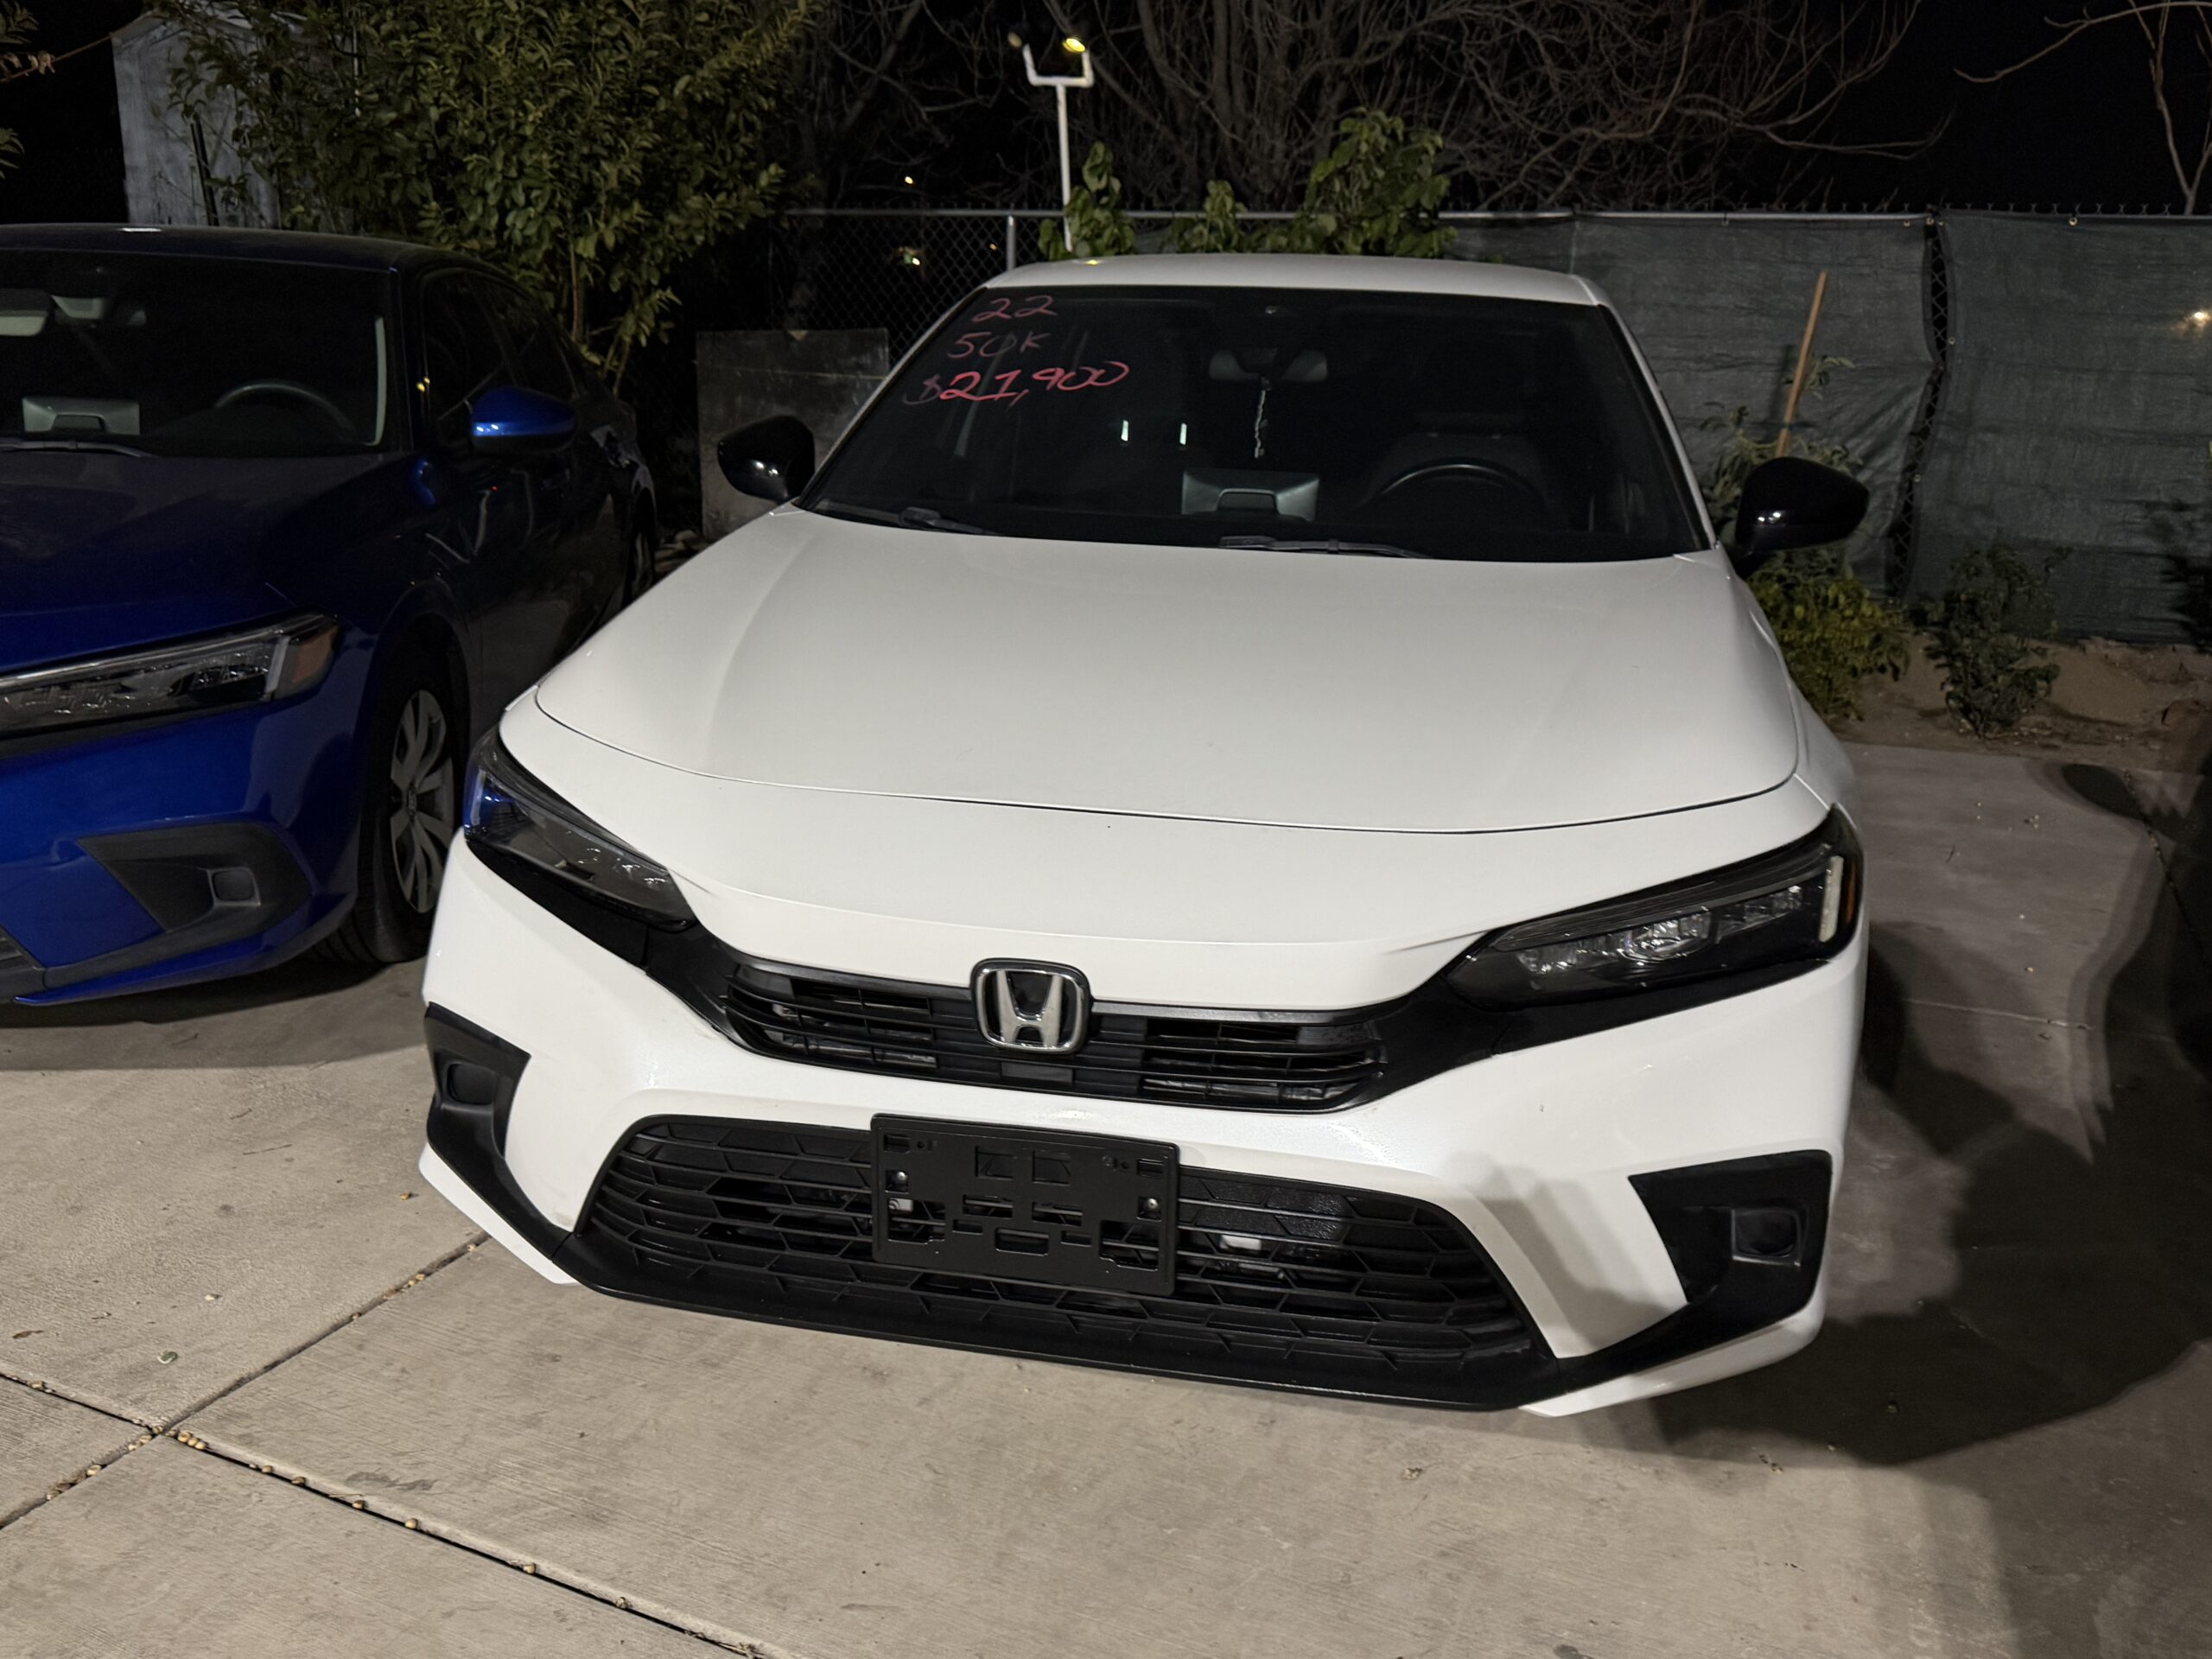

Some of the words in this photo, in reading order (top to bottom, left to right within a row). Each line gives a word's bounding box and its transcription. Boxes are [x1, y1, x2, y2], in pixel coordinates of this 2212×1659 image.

[971, 295, 1058, 322] 22
[946, 330, 1051, 358] 50K
[903, 360, 1130, 409] $21,900
